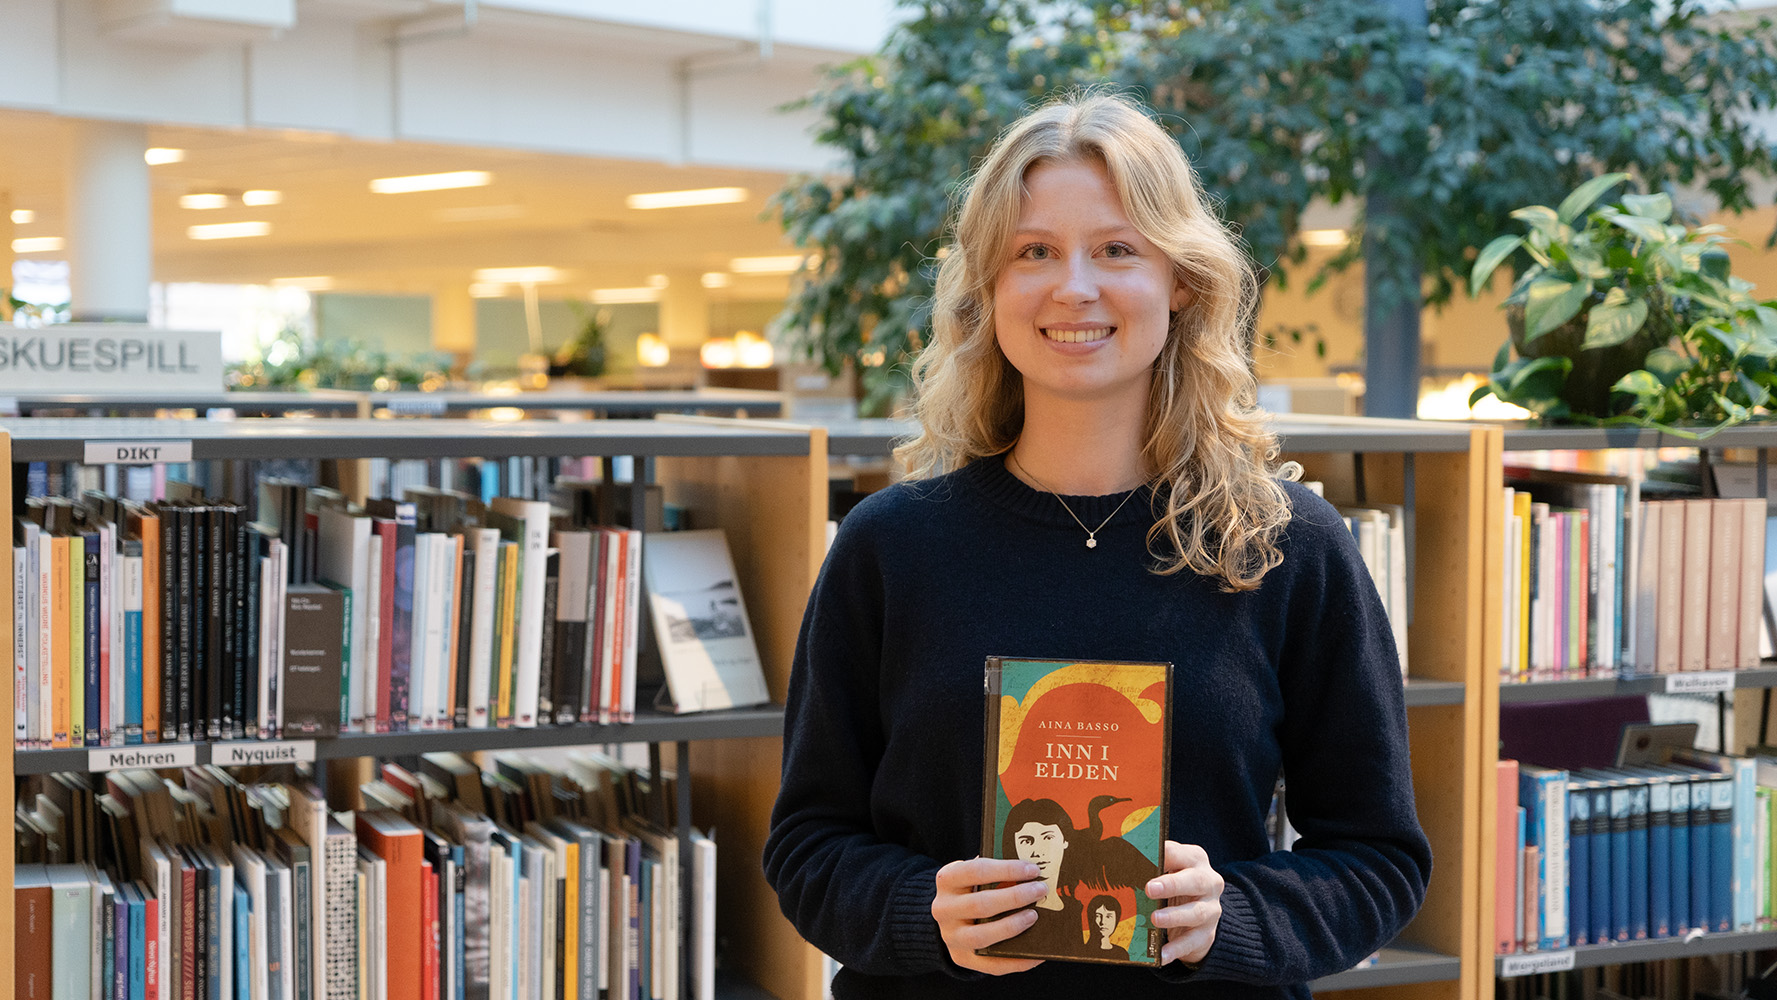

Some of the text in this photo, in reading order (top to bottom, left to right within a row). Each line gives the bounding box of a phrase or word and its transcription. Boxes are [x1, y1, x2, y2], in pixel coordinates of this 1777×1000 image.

[116, 447, 162, 460] DIKT
[1038, 720, 1119, 732] AINA BASSO
[109, 751, 176, 767] Mehren
[231, 745, 296, 765] Nyquist
[1045, 742, 1109, 761] INN I
[1034, 762, 1119, 782] ELDEN
